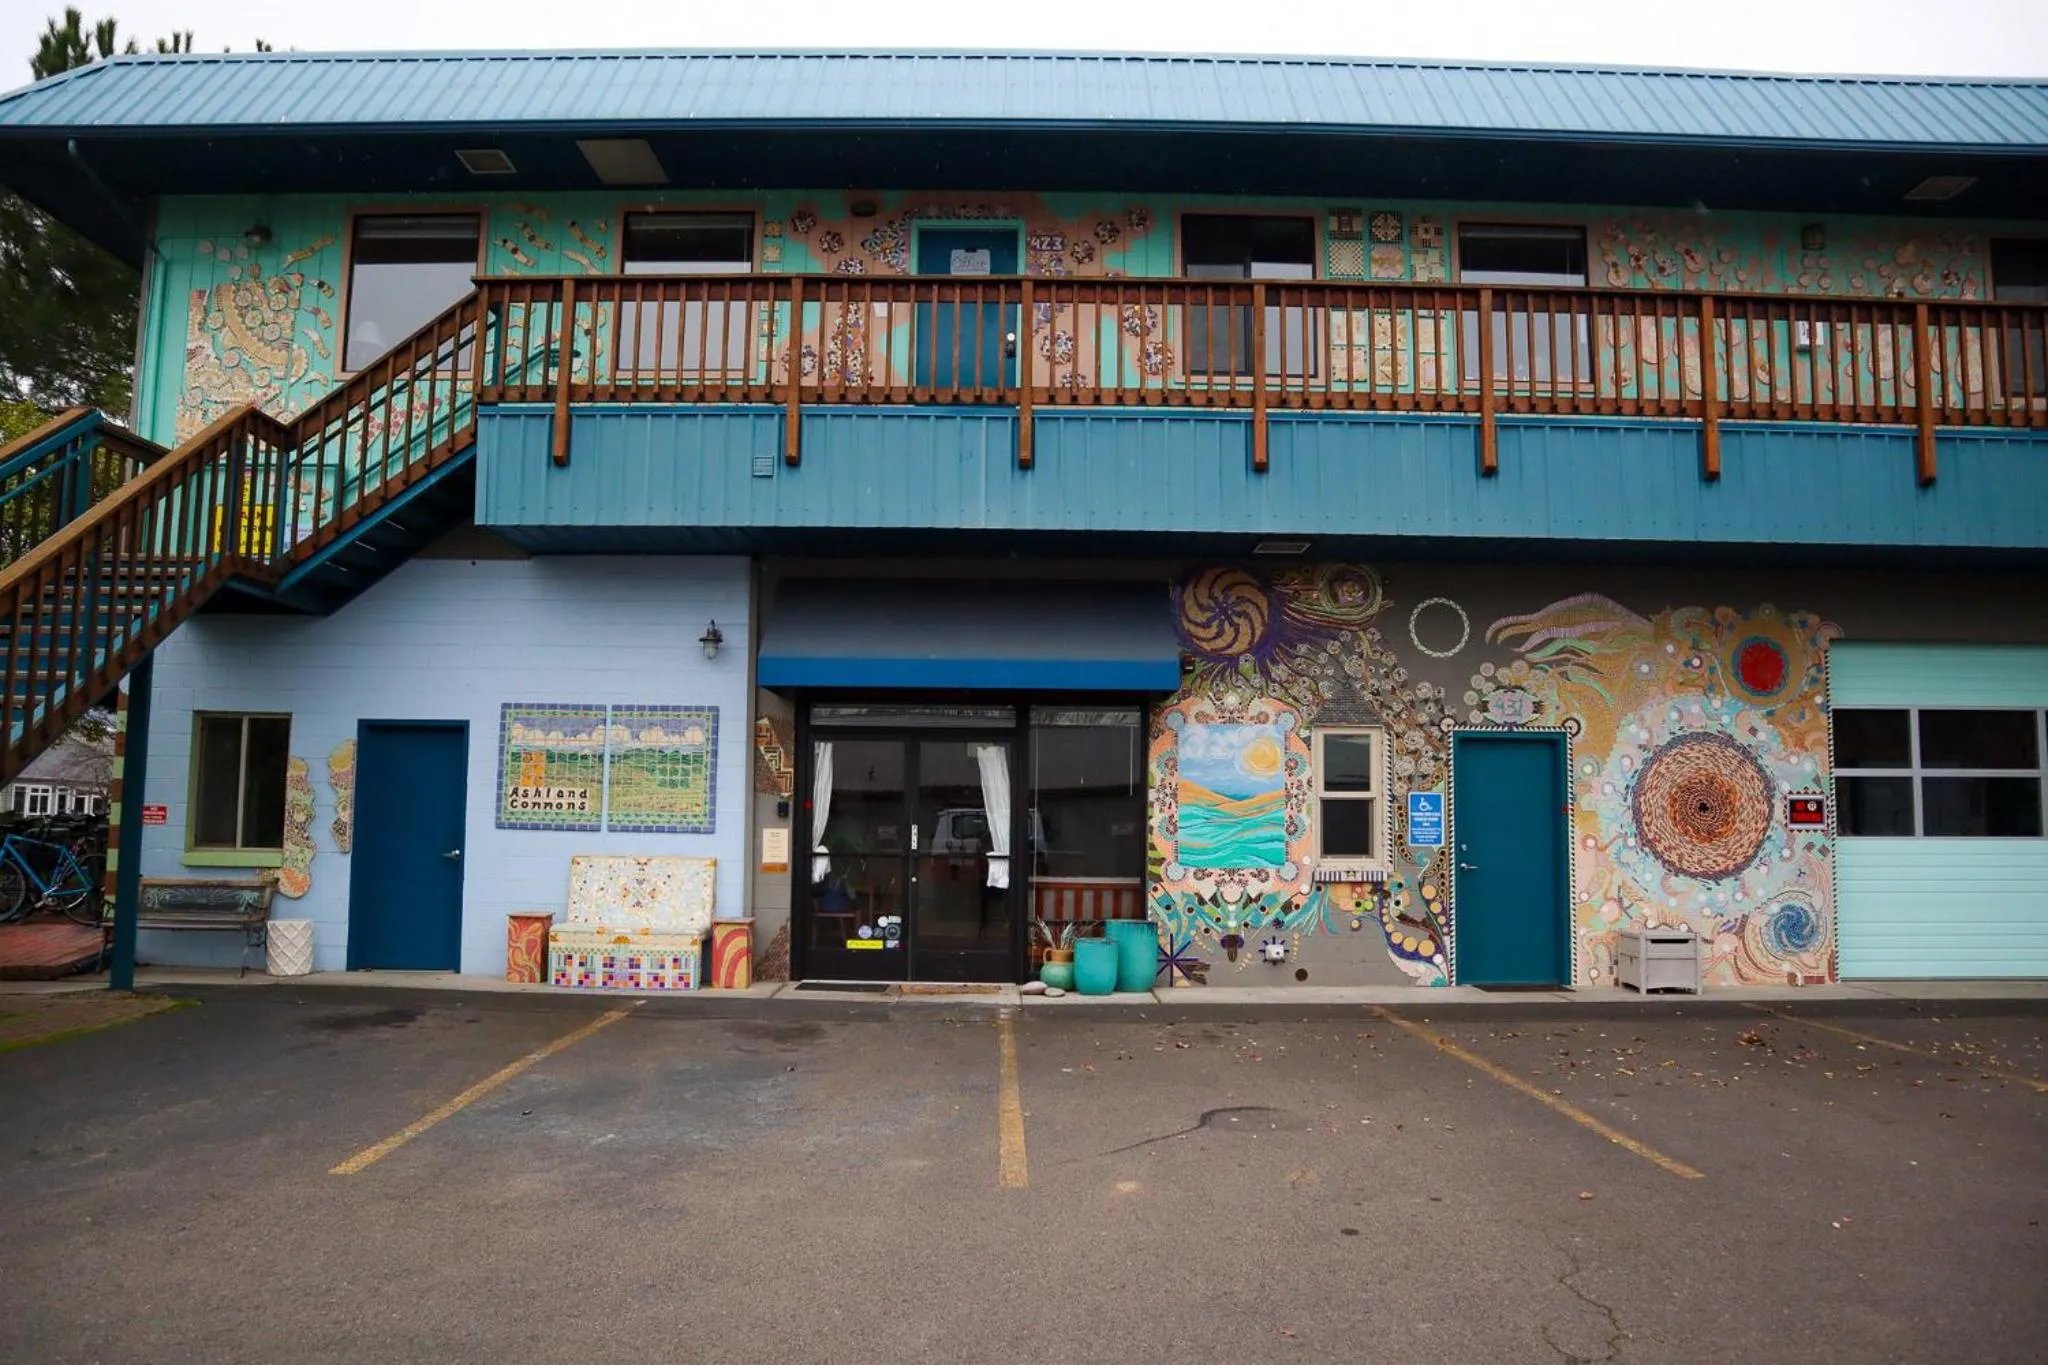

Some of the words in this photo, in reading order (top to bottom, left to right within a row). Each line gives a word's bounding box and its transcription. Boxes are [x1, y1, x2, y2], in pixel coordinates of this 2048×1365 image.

[1031, 236, 1063, 251] 423
[509, 786, 588, 799] Ashland
[510, 799, 587, 811] Commons
